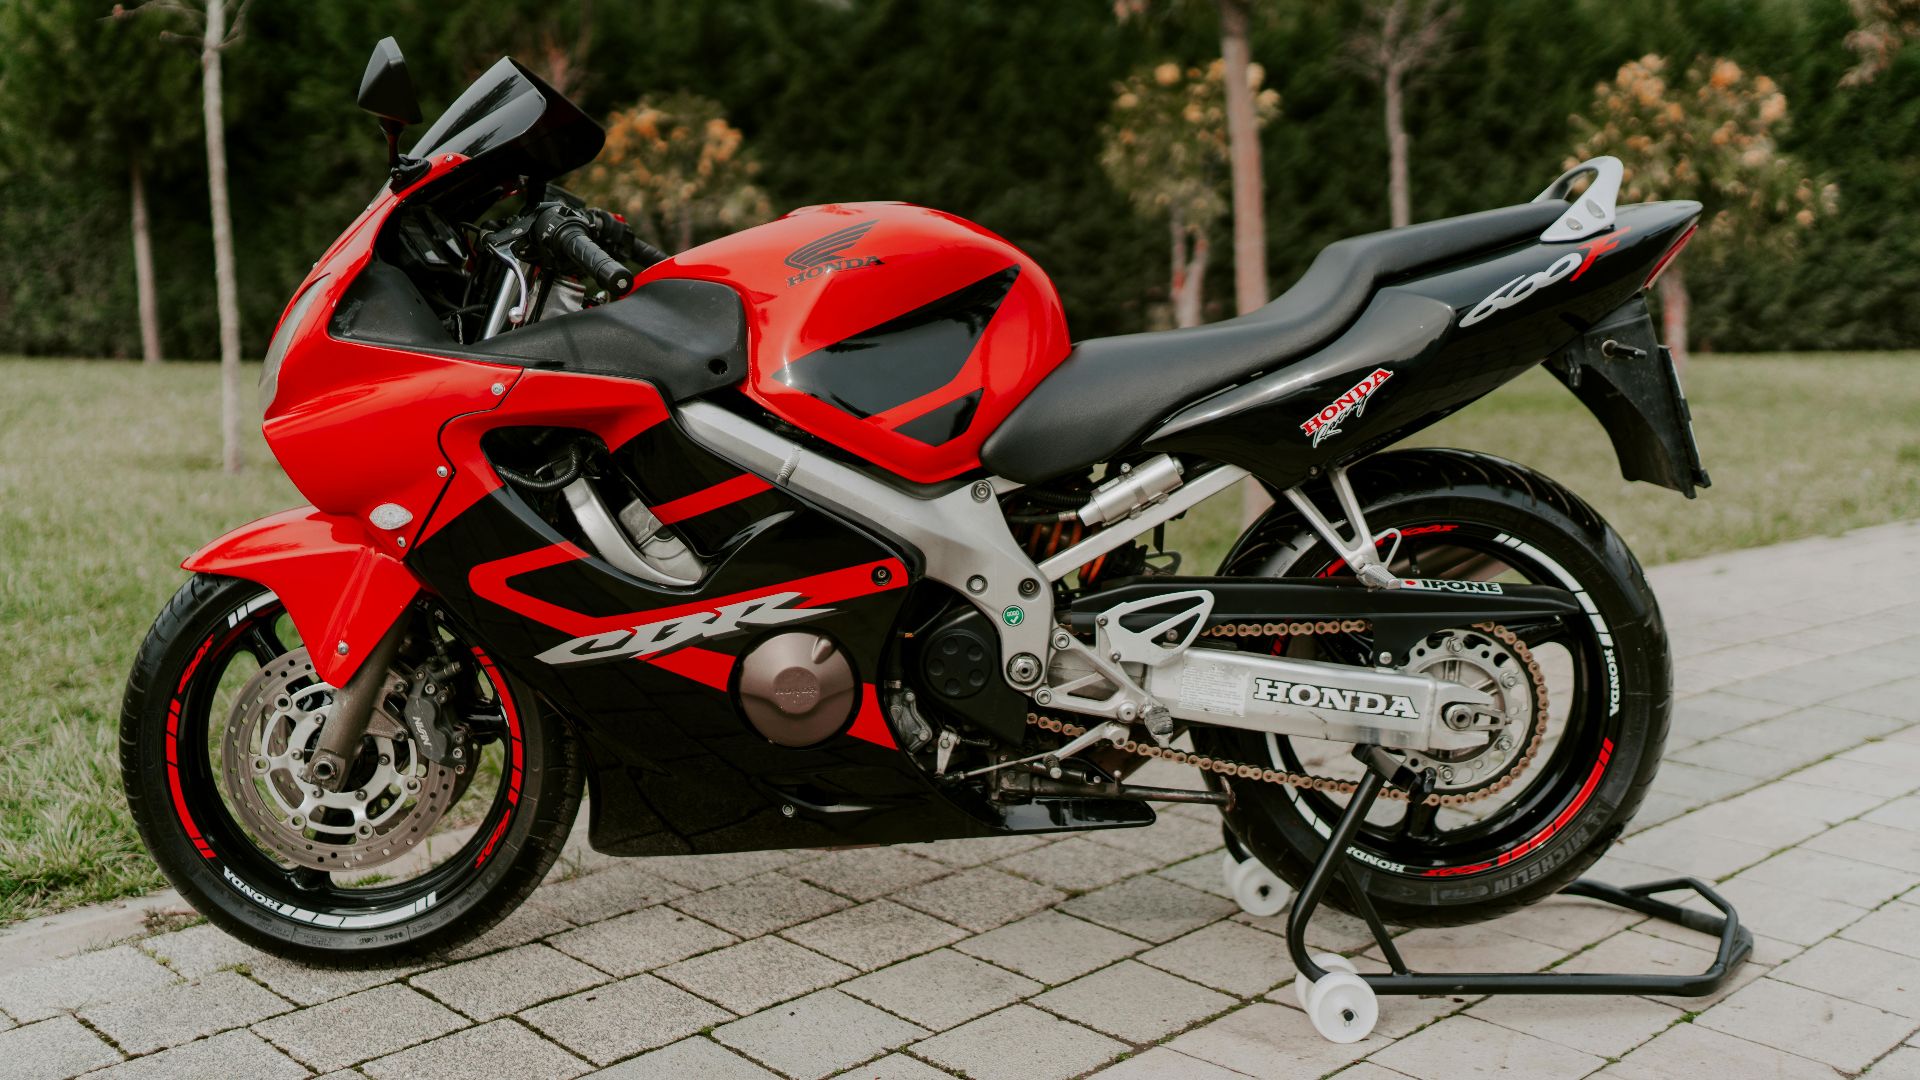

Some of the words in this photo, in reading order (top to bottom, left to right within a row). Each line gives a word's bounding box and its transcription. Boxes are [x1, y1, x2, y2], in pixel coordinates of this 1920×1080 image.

[786, 256, 885, 288] HONDA
[1300, 368, 1393, 436] HONDA
[1420, 580, 1500, 594] IPONE
[533, 591, 838, 665] CBR
[1253, 677, 1420, 719] HONDA
[1604, 648, 1620, 717] HONDA
[223, 865, 281, 911] HONDA
[1494, 826, 1590, 894] MICHELIN
